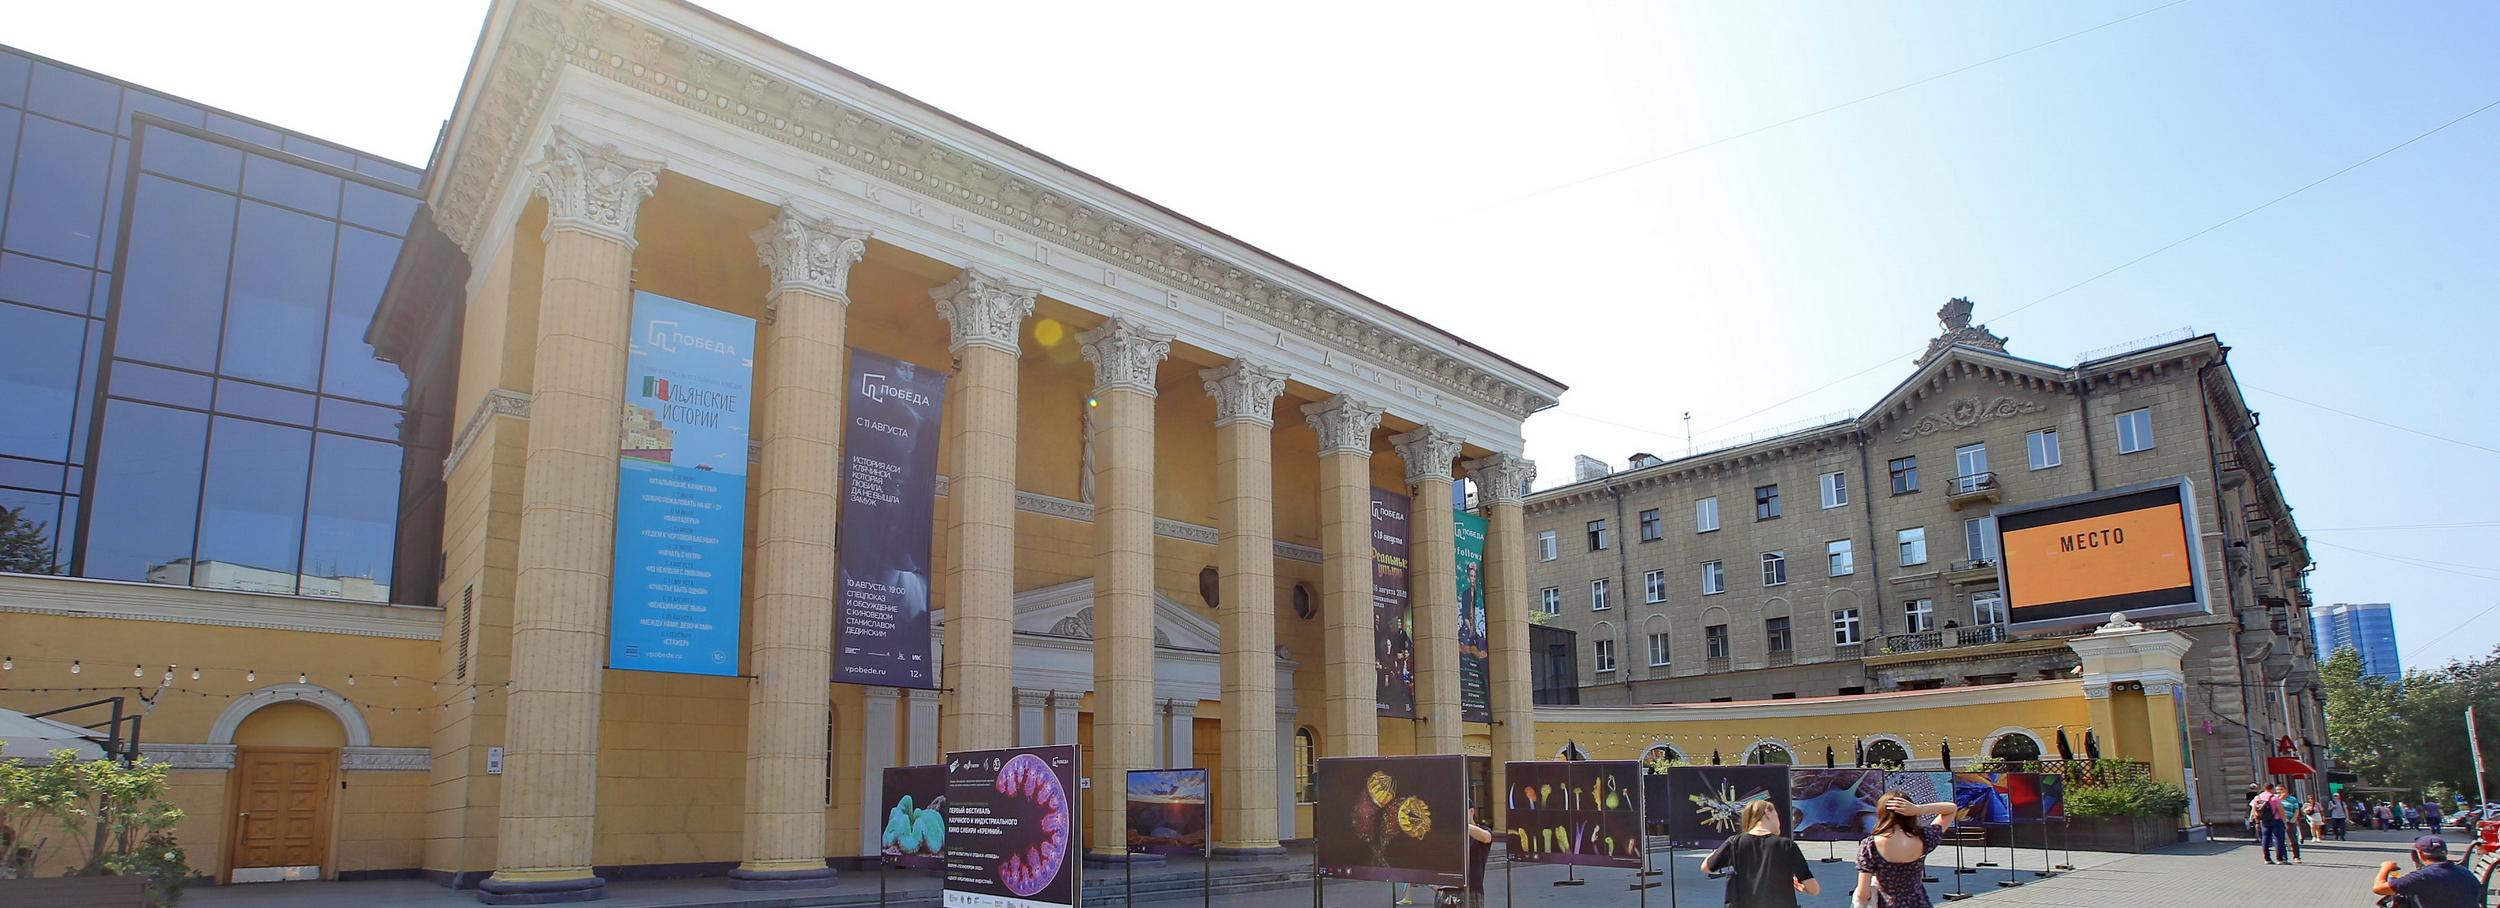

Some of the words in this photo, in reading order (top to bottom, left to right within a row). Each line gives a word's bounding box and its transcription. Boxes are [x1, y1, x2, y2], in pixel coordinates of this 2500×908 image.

[865, 182, 1007, 247] КИНО
[1034, 241, 1333, 369] ПОБЕДА
[673, 332, 736, 355] ПОБЕДА
[880, 384, 930, 406] ПОБЕДА
[663, 402, 719, 430] ИСТОРИИ
[856, 417, 863, 426] С
[864, 418, 869, 427] 11
[869, 421, 909, 438] АВГУСТА
[853, 455, 887, 469] ИСТОРИЯ
[887, 463, 901, 473] АСИ
[852, 471, 884, 485] КОТОРАЯ
[851, 479, 884, 493] ЛЮБИЛА,
[850, 486, 861, 495] ДА
[862, 489, 873, 498] НЕ
[873, 491, 900, 504] ВЫШЛА
[850, 494, 877, 507] ЗАМУЖ
[1380, 507, 1405, 521] ПОБЕДА
[1462, 528, 1485, 541] ПОБЕДА
[2060, 527, 2125, 553] МЕСТО
[846, 579, 855, 587] 10
[855, 580, 887, 592] АВГУСТА
[888, 585, 906, 595] 19:00
[846, 590, 886, 602] СПЕЦПОКАЗ
[853, 600, 899, 613] ОБСУЖДЕНИЕ
[846, 608, 852, 616] С
[852, 609, 894, 621] КИНОВЕДОМ
[846, 618, 896, 630] СТАНИСЛАВОМ
[845, 627, 887, 637] ДЕДИНСКИМ
[844, 665, 887, 676] vpobede.ru
[948, 806, 965, 814] ПЕРВЫЙ
[965, 807, 991, 815] ФЕСТИВАЛЬ
[948, 817, 970, 825] НАУЧНОГО
[974, 818, 1018, 826] ИНДУСТРИАЛЬНОГО
